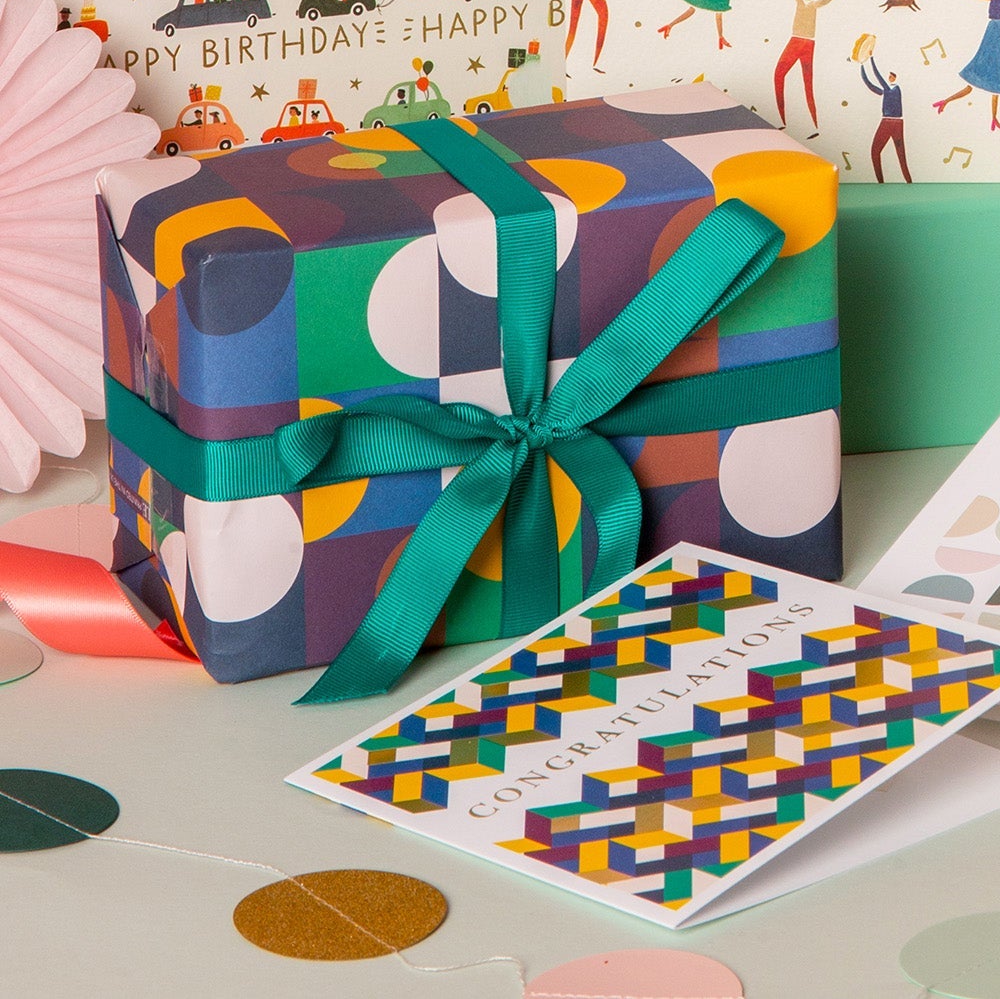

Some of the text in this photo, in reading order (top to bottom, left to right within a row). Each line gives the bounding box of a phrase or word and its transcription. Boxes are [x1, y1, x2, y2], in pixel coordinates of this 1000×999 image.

[202, 20, 368, 68] BIRTHDAY
[422, 3, 529, 42] HAPPY
[468, 602, 815, 819] CONGRATULATIONS
